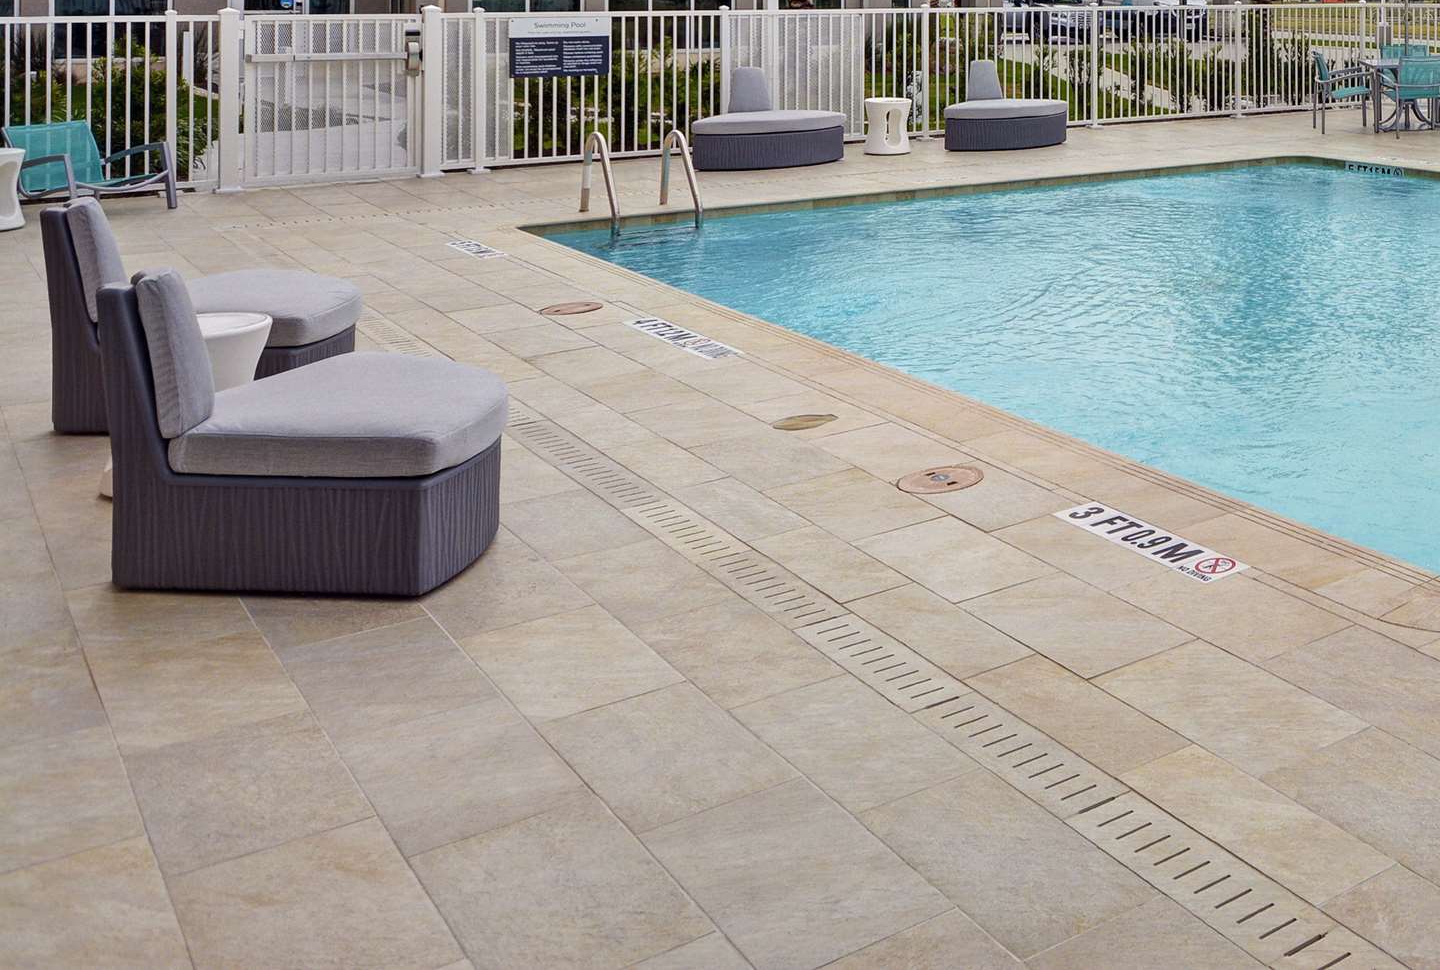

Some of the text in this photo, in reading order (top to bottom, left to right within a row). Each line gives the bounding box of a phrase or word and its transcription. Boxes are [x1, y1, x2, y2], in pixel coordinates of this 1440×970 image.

[534, 21, 570, 30] Swimming
[1068, 506, 1105, 520] 3
[1177, 564, 1190, 574] NO
